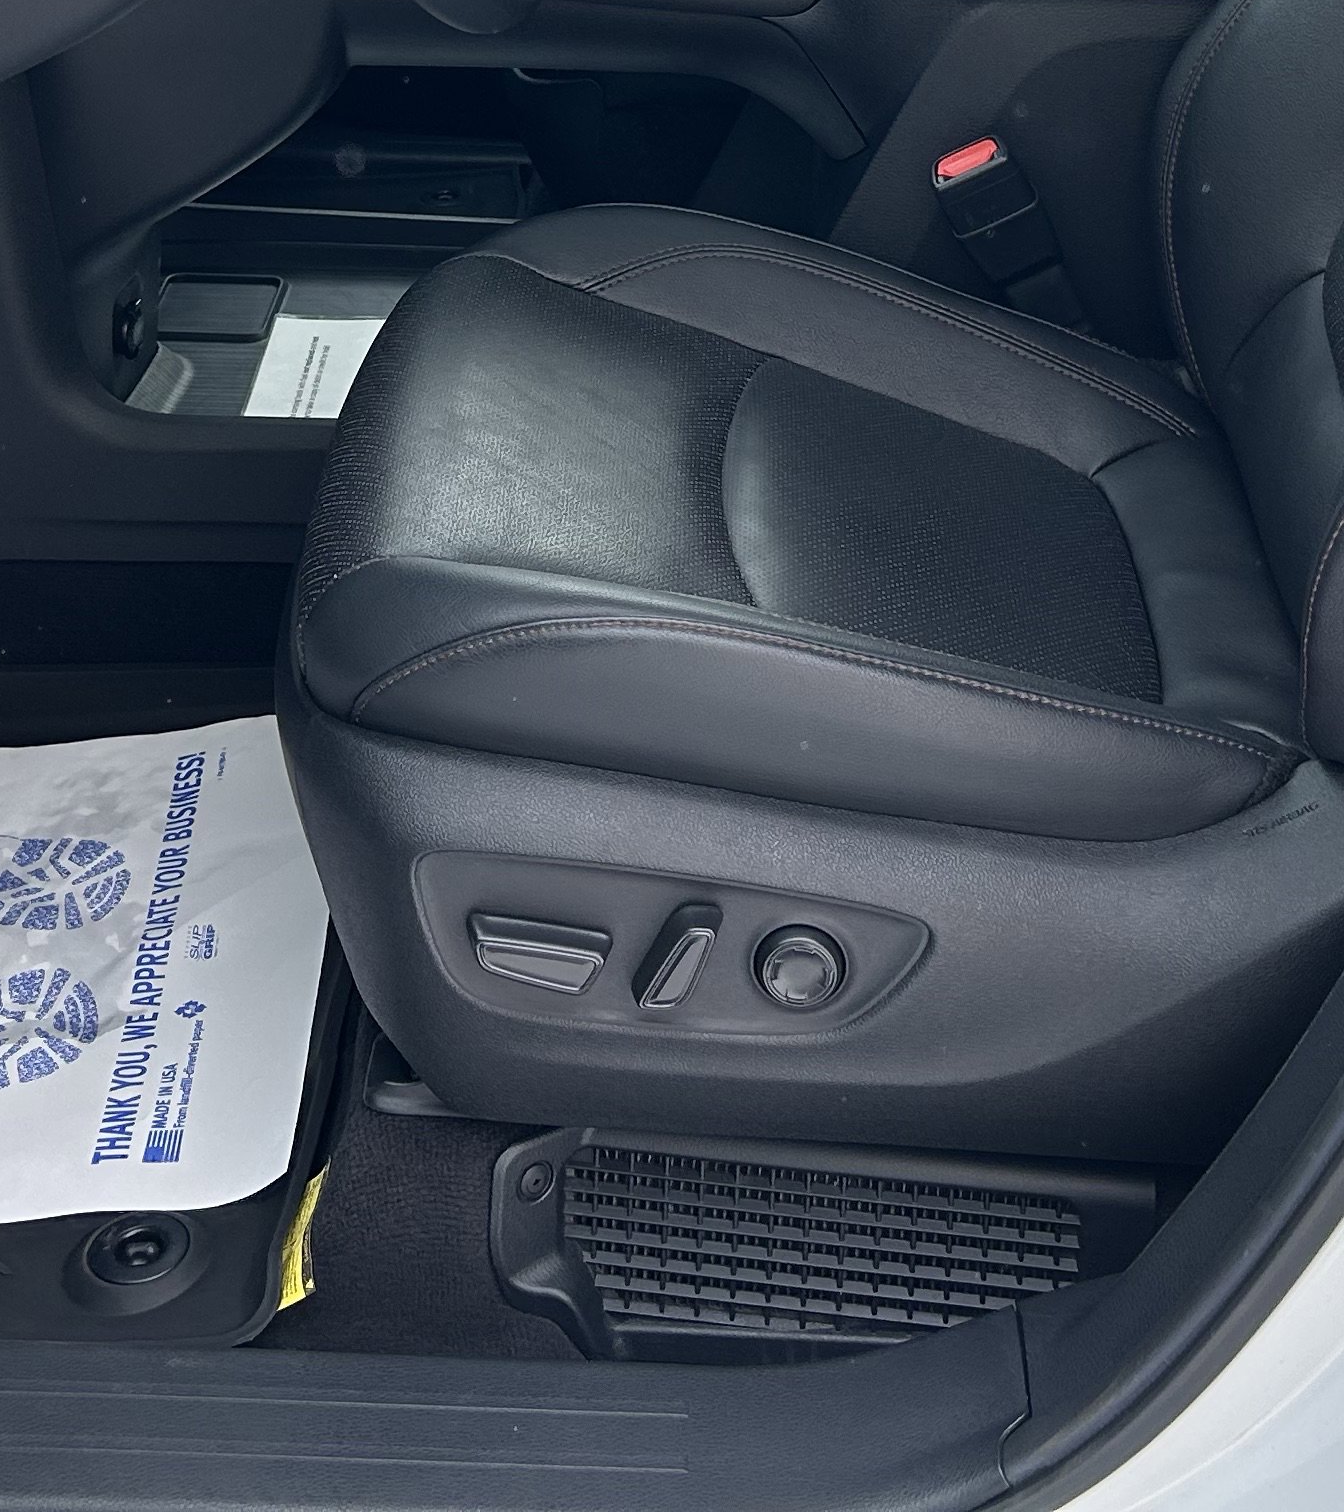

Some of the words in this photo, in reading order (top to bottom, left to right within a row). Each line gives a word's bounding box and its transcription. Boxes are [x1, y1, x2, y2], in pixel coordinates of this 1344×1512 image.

[163, 751, 206, 843] BUSINESS!
[152, 844, 191, 895] YOUR
[130, 894, 181, 1006] APPRECIATE
[189, 924, 202, 959] SLIP
[204, 924, 216, 959] GRIP
[121, 1012, 159, 1043] WE
[109, 1043, 158, 1092] YOU,
[161, 1063, 179, 1084] USA
[158, 1086, 173, 1097] IN
[91, 1094, 141, 1165] THANK
[151, 1099, 171, 1129] MADE
[173, 1106, 189, 1128] From
